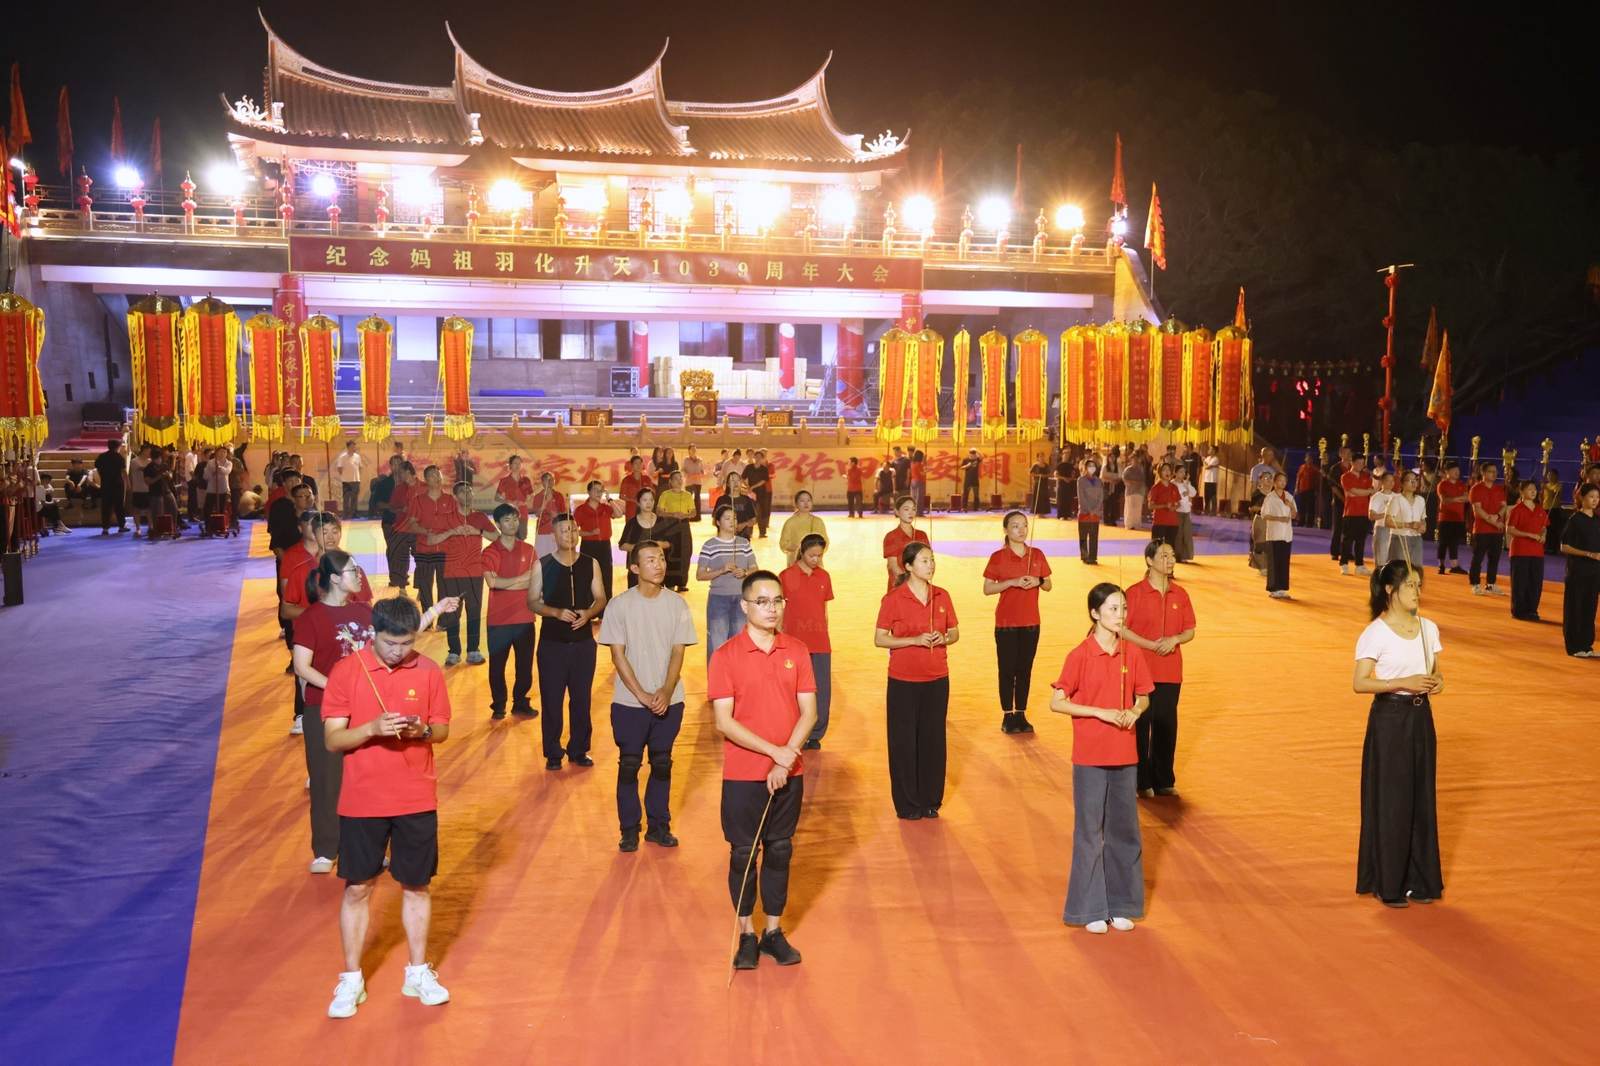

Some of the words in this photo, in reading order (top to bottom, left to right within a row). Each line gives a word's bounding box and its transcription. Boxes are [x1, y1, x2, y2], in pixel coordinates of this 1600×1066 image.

[325, 245, 889, 283] 纪念妈祖羽化升天1039周年大会
